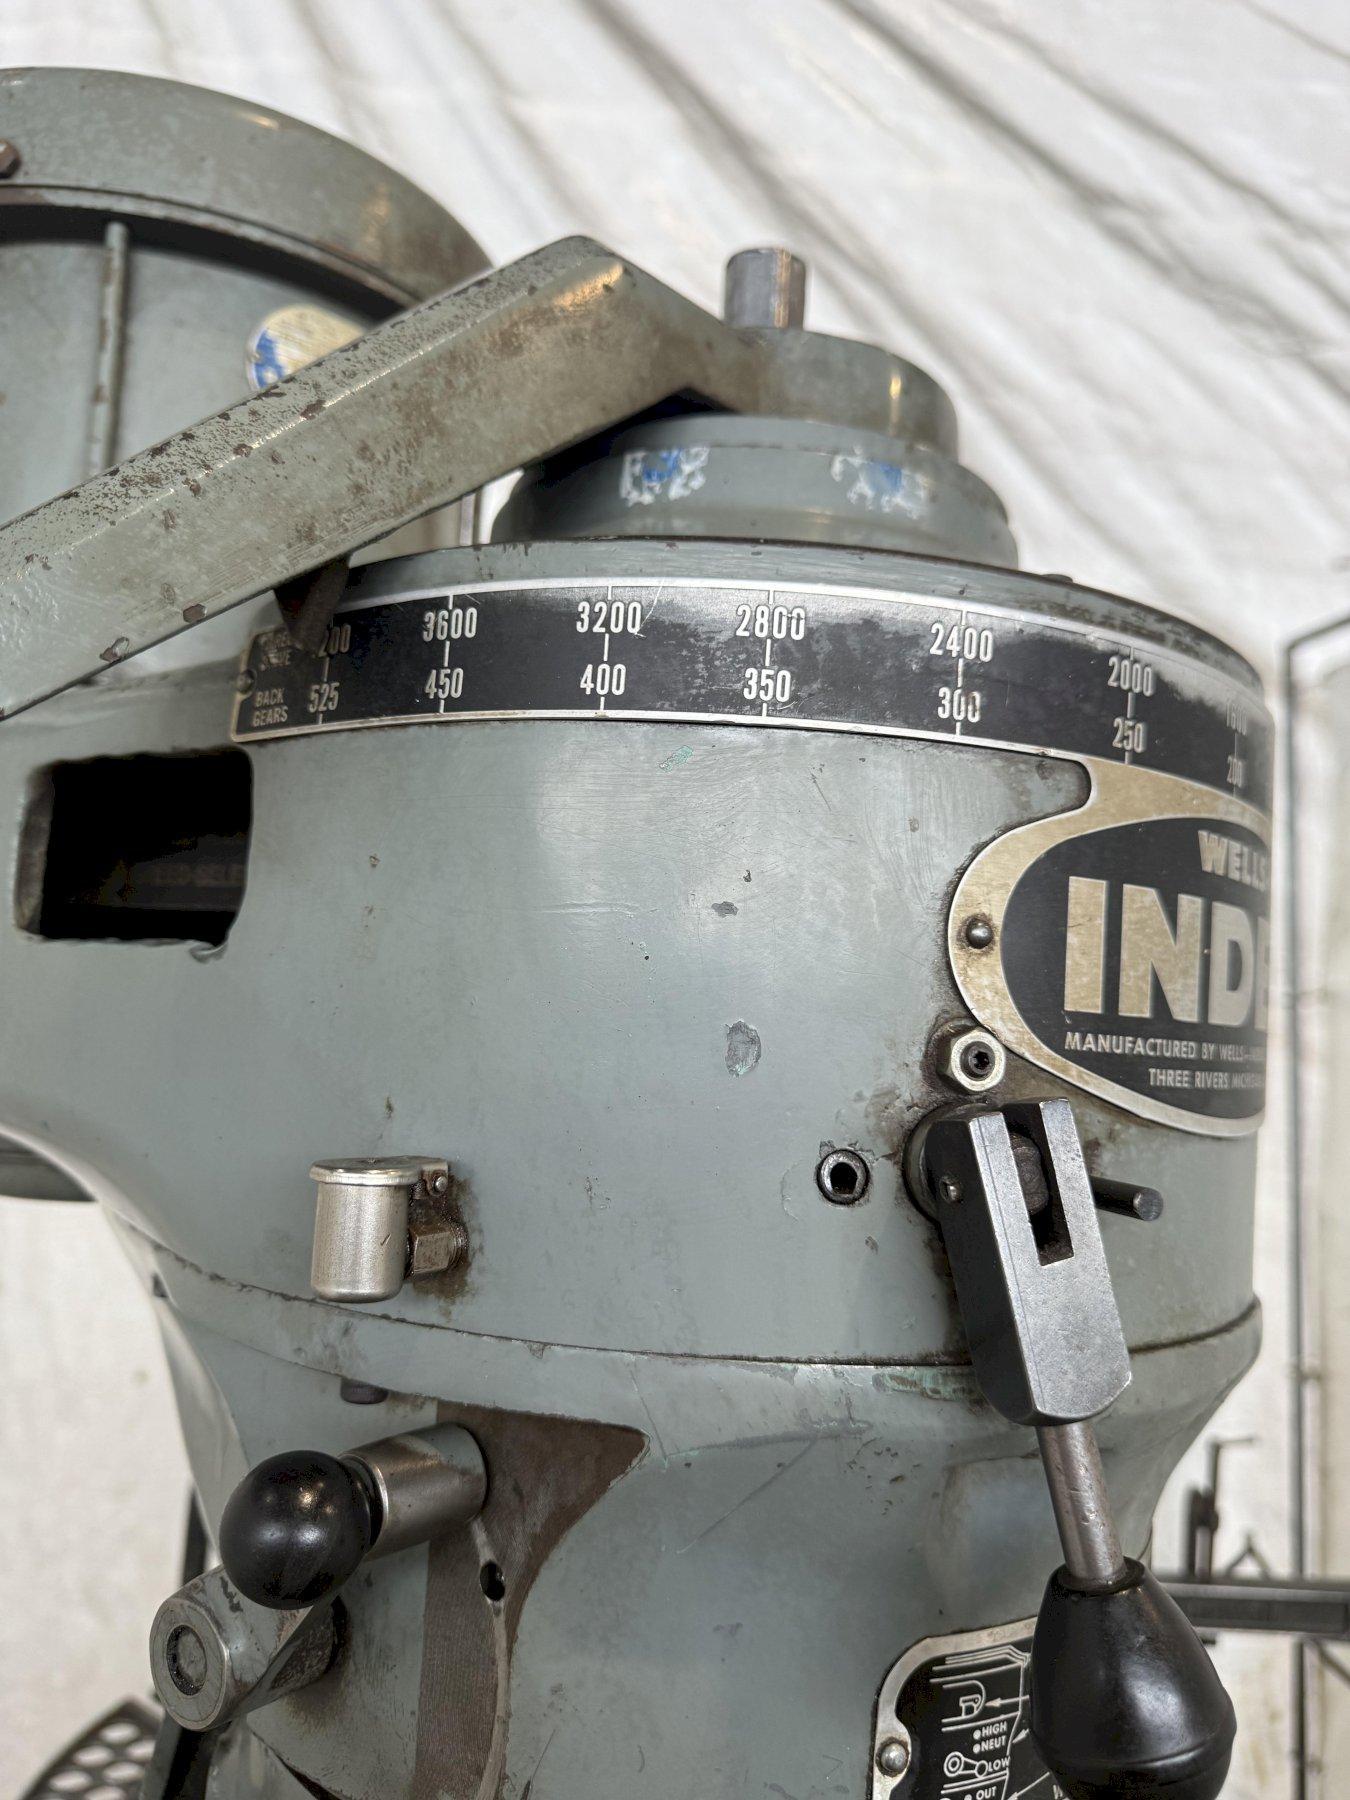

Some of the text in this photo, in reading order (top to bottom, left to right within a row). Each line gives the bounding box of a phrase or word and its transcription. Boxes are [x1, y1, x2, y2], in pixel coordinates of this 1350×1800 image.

[422, 607, 478, 642] 3600
[576, 601, 642, 634] 3200
[736, 604, 806, 641] 2800
[929, 622, 994, 663] 2400
[1108, 655, 1155, 697] 2000
[255, 688, 284, 708] BACK
[307, 682, 340, 713] 525
[425, 667, 464, 699] 450
[580, 663, 627, 695] 400
[743, 667, 791, 702] 350
[937, 686, 982, 723] 300
[1112, 716, 1147, 753] 250
[252, 705, 289, 728] GEARS
[1064, 1032, 1196, 1060] MANUFACTURED
[1201, 1042, 1215, 1060] BY
[1148, 1067, 1190, 1088] THREE
[1194, 1070, 1229, 1089] RIVERS
[981, 1721, 1007, 1737] HIGH
[981, 1735, 1007, 1752] NEUT
[987, 1756, 1011, 1773] LOW
[975, 1786, 997, 1800] OUT
